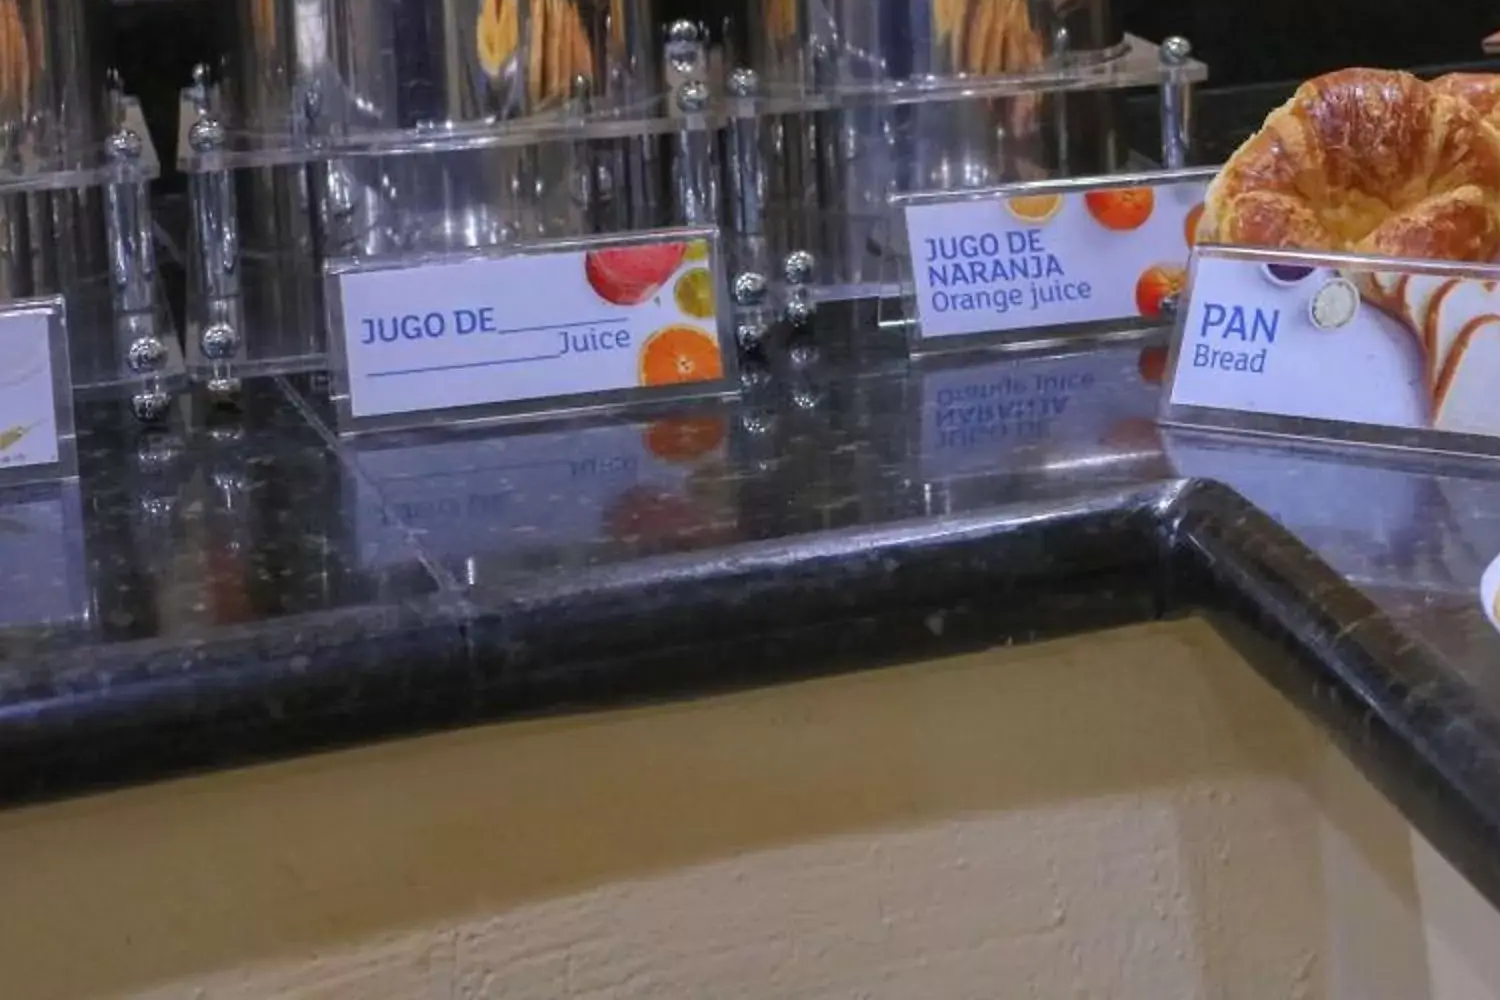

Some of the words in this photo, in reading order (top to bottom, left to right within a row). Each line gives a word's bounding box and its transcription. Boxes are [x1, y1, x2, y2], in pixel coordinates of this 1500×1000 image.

[924, 233, 999, 262] JUGO
[1007, 229, 1045, 255] DE
[927, 254, 1064, 288] NARANJA
[931, 286, 1024, 314] Orange
[1029, 279, 1092, 310] juice
[361, 312, 445, 344] JUGO
[1199, 303, 1281, 343] PAN
[559, 327, 632, 355] Juice
[1193, 343, 1267, 374] Bread
